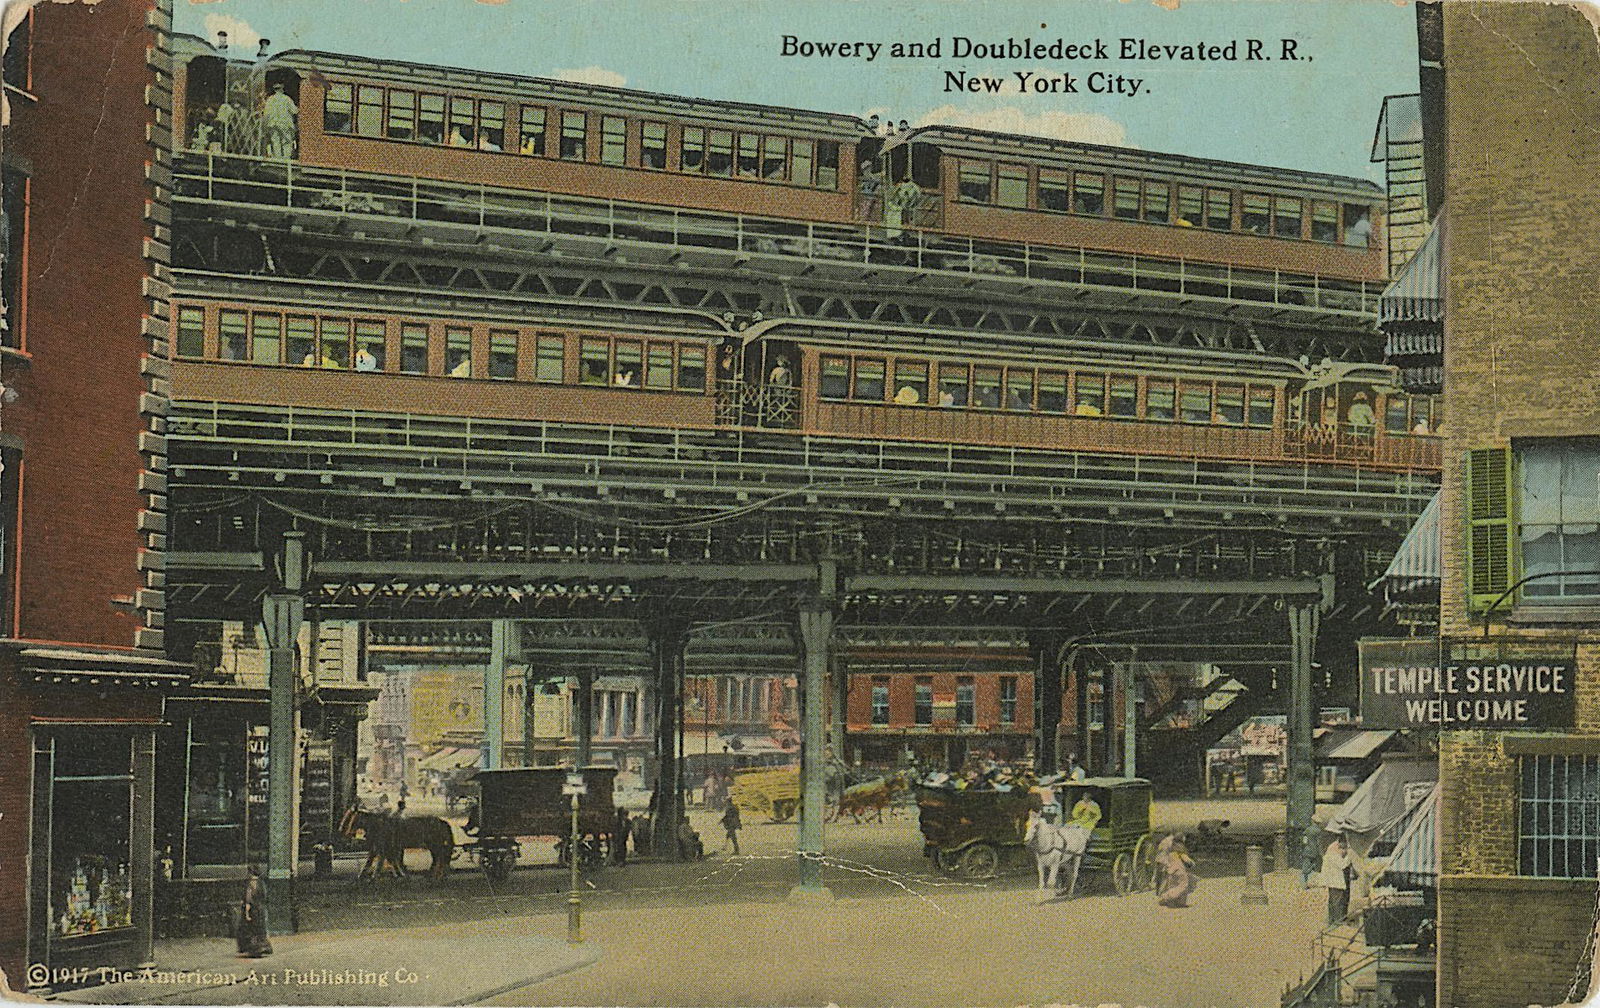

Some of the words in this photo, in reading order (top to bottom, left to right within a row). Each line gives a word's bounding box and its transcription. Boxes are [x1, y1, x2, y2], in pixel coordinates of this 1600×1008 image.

[1371, 665, 1459, 695] TEMPLE
[1466, 663, 1566, 694] SERVICE
[1405, 698, 1529, 724] WELCOME
